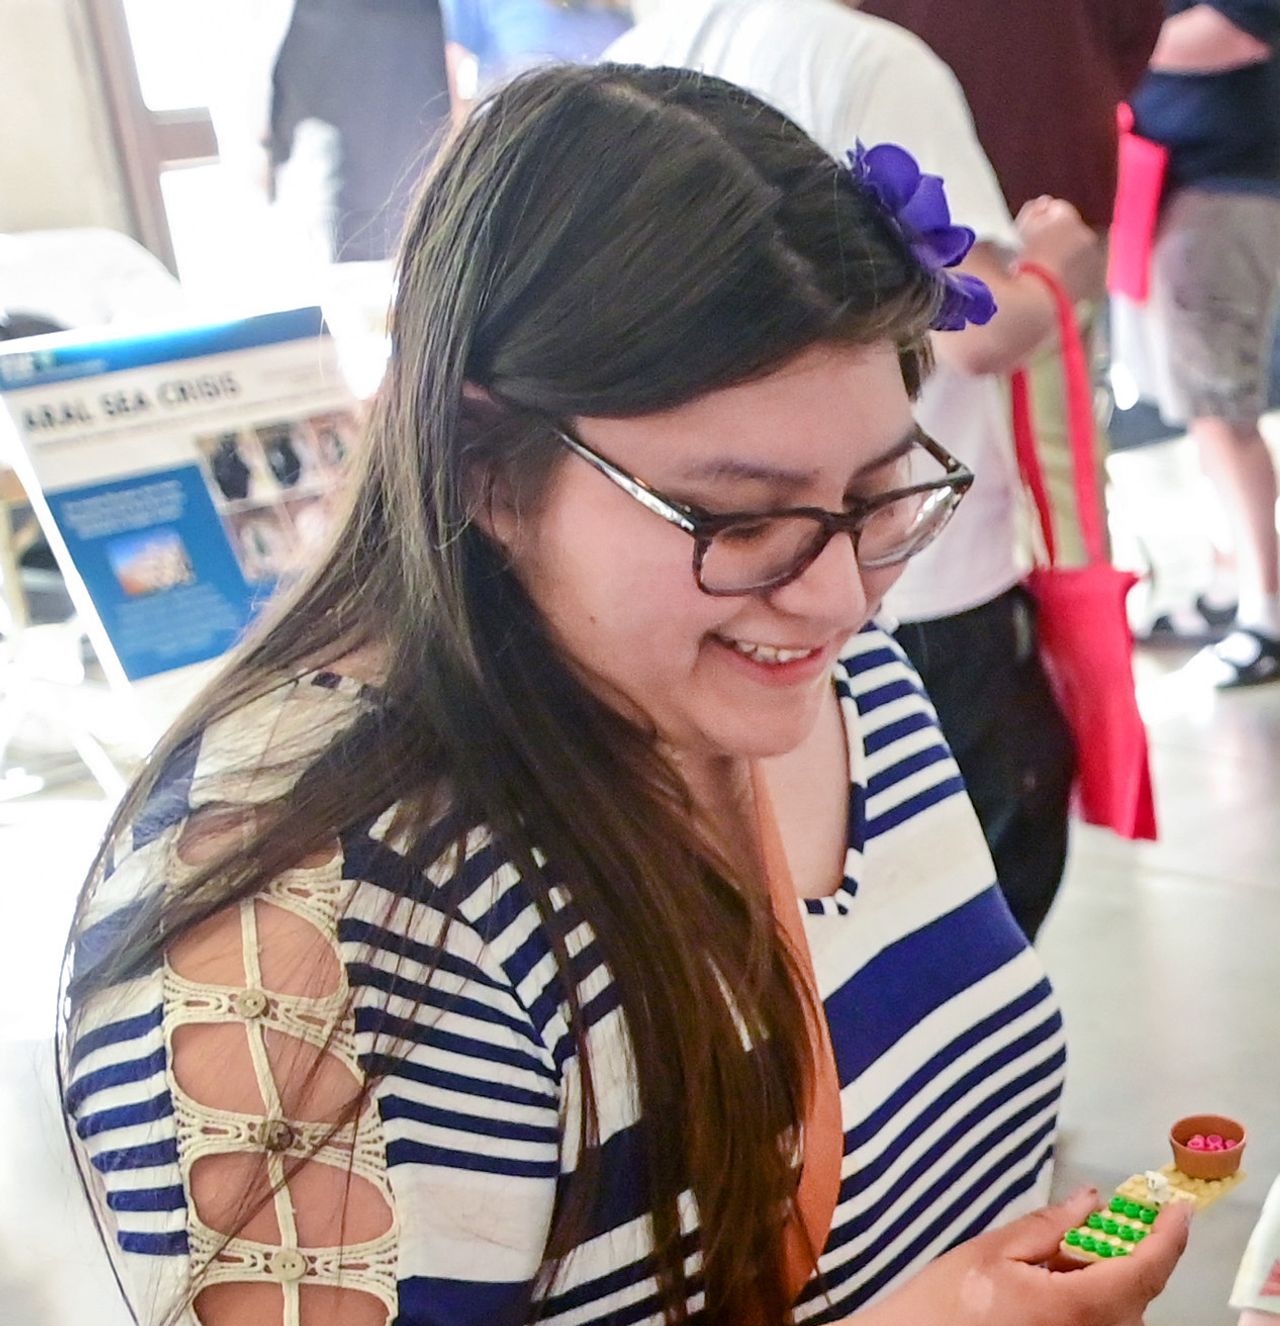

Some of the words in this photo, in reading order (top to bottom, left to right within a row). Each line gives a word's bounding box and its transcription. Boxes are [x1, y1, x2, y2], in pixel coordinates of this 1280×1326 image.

[23, 401, 93, 432] ARAL
[101, 388, 150, 417] SEA
[156, 371, 241, 410] CRISIS
